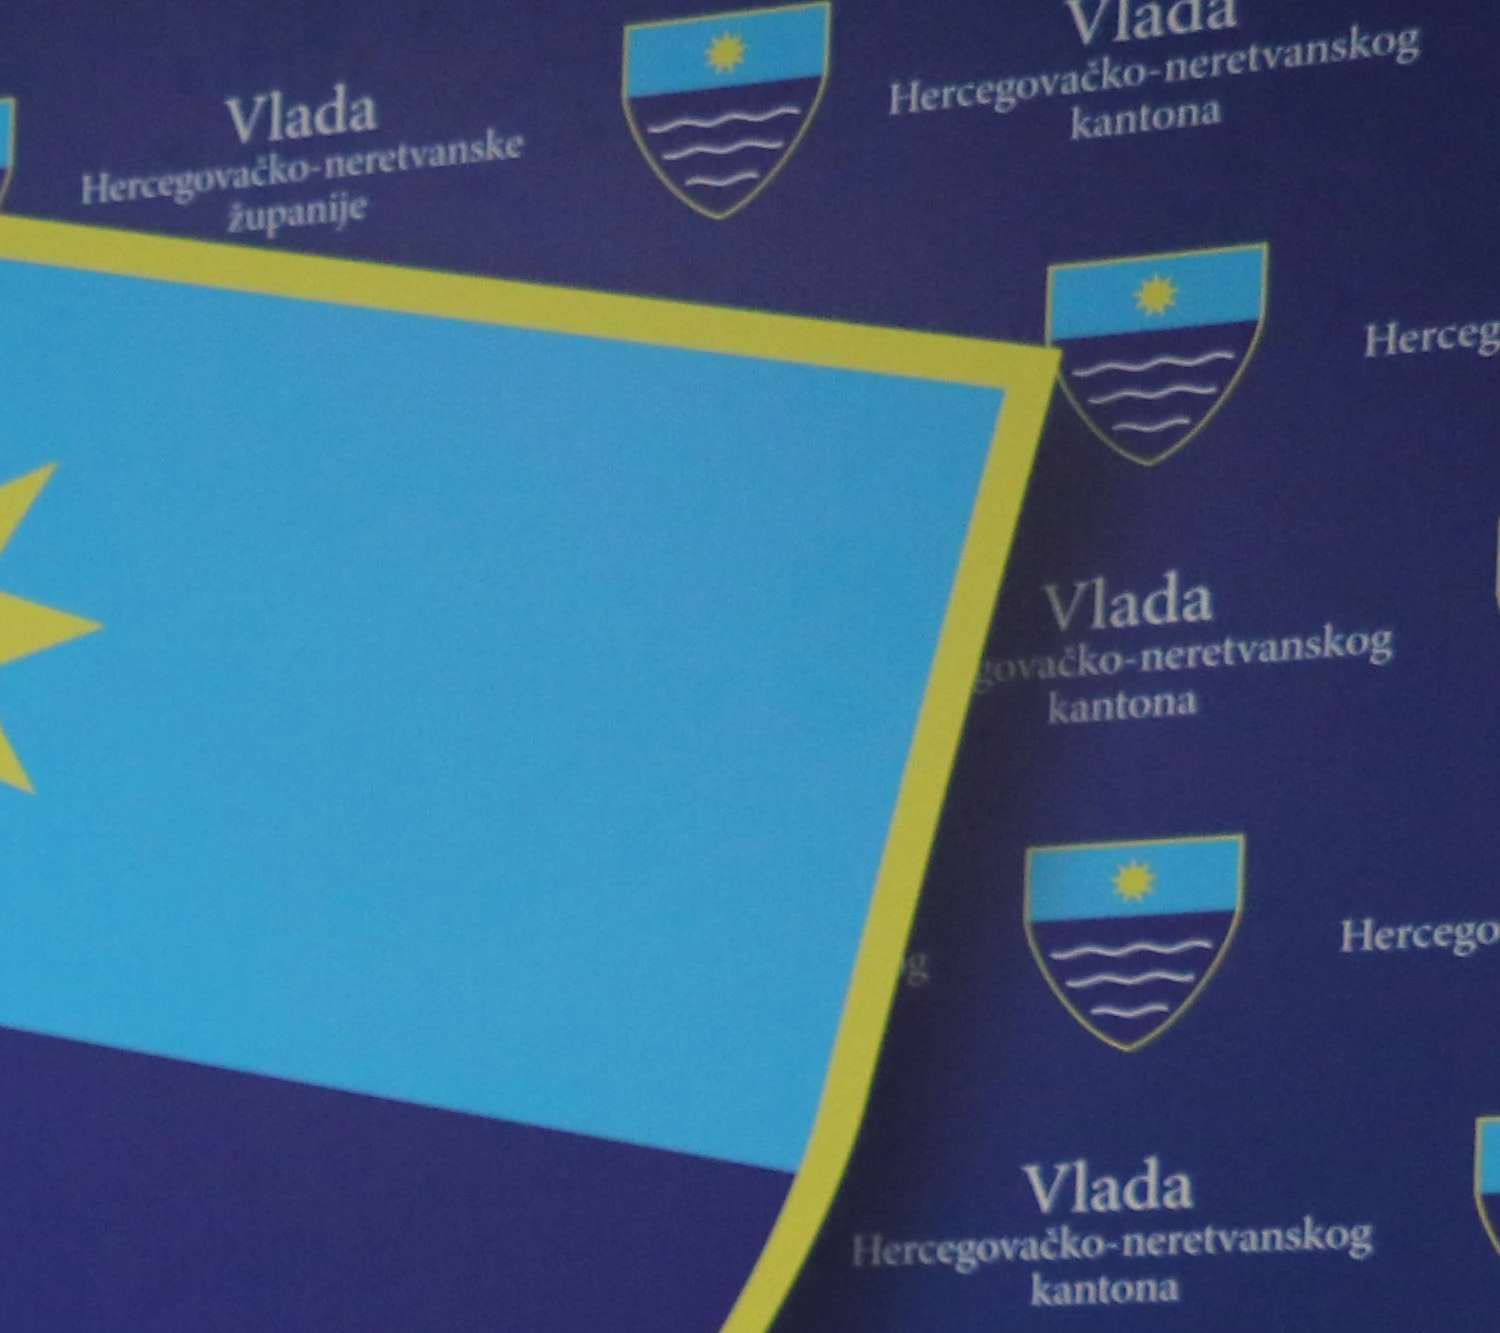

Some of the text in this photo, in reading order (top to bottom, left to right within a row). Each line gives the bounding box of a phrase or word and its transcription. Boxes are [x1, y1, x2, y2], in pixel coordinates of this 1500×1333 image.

[888, 24, 1420, 116] Hercegovačko-neretvanskog
[225, 82, 379, 144] Vlada
[1069, 99, 1222, 141] kantona
[81, 125, 525, 205] Hercegovačko-neretvanske
[227, 191, 369, 238] županije
[1045, 569, 1214, 631] Vlada
[975, 623, 1394, 694] govačko-neretvanskog
[1048, 688, 1199, 725] kantona
[1022, 1154, 1195, 1214] Vlada
[851, 1216, 1375, 1274] Hercegovačko-neretvanskog
[1030, 1272, 1180, 1307] kantona
